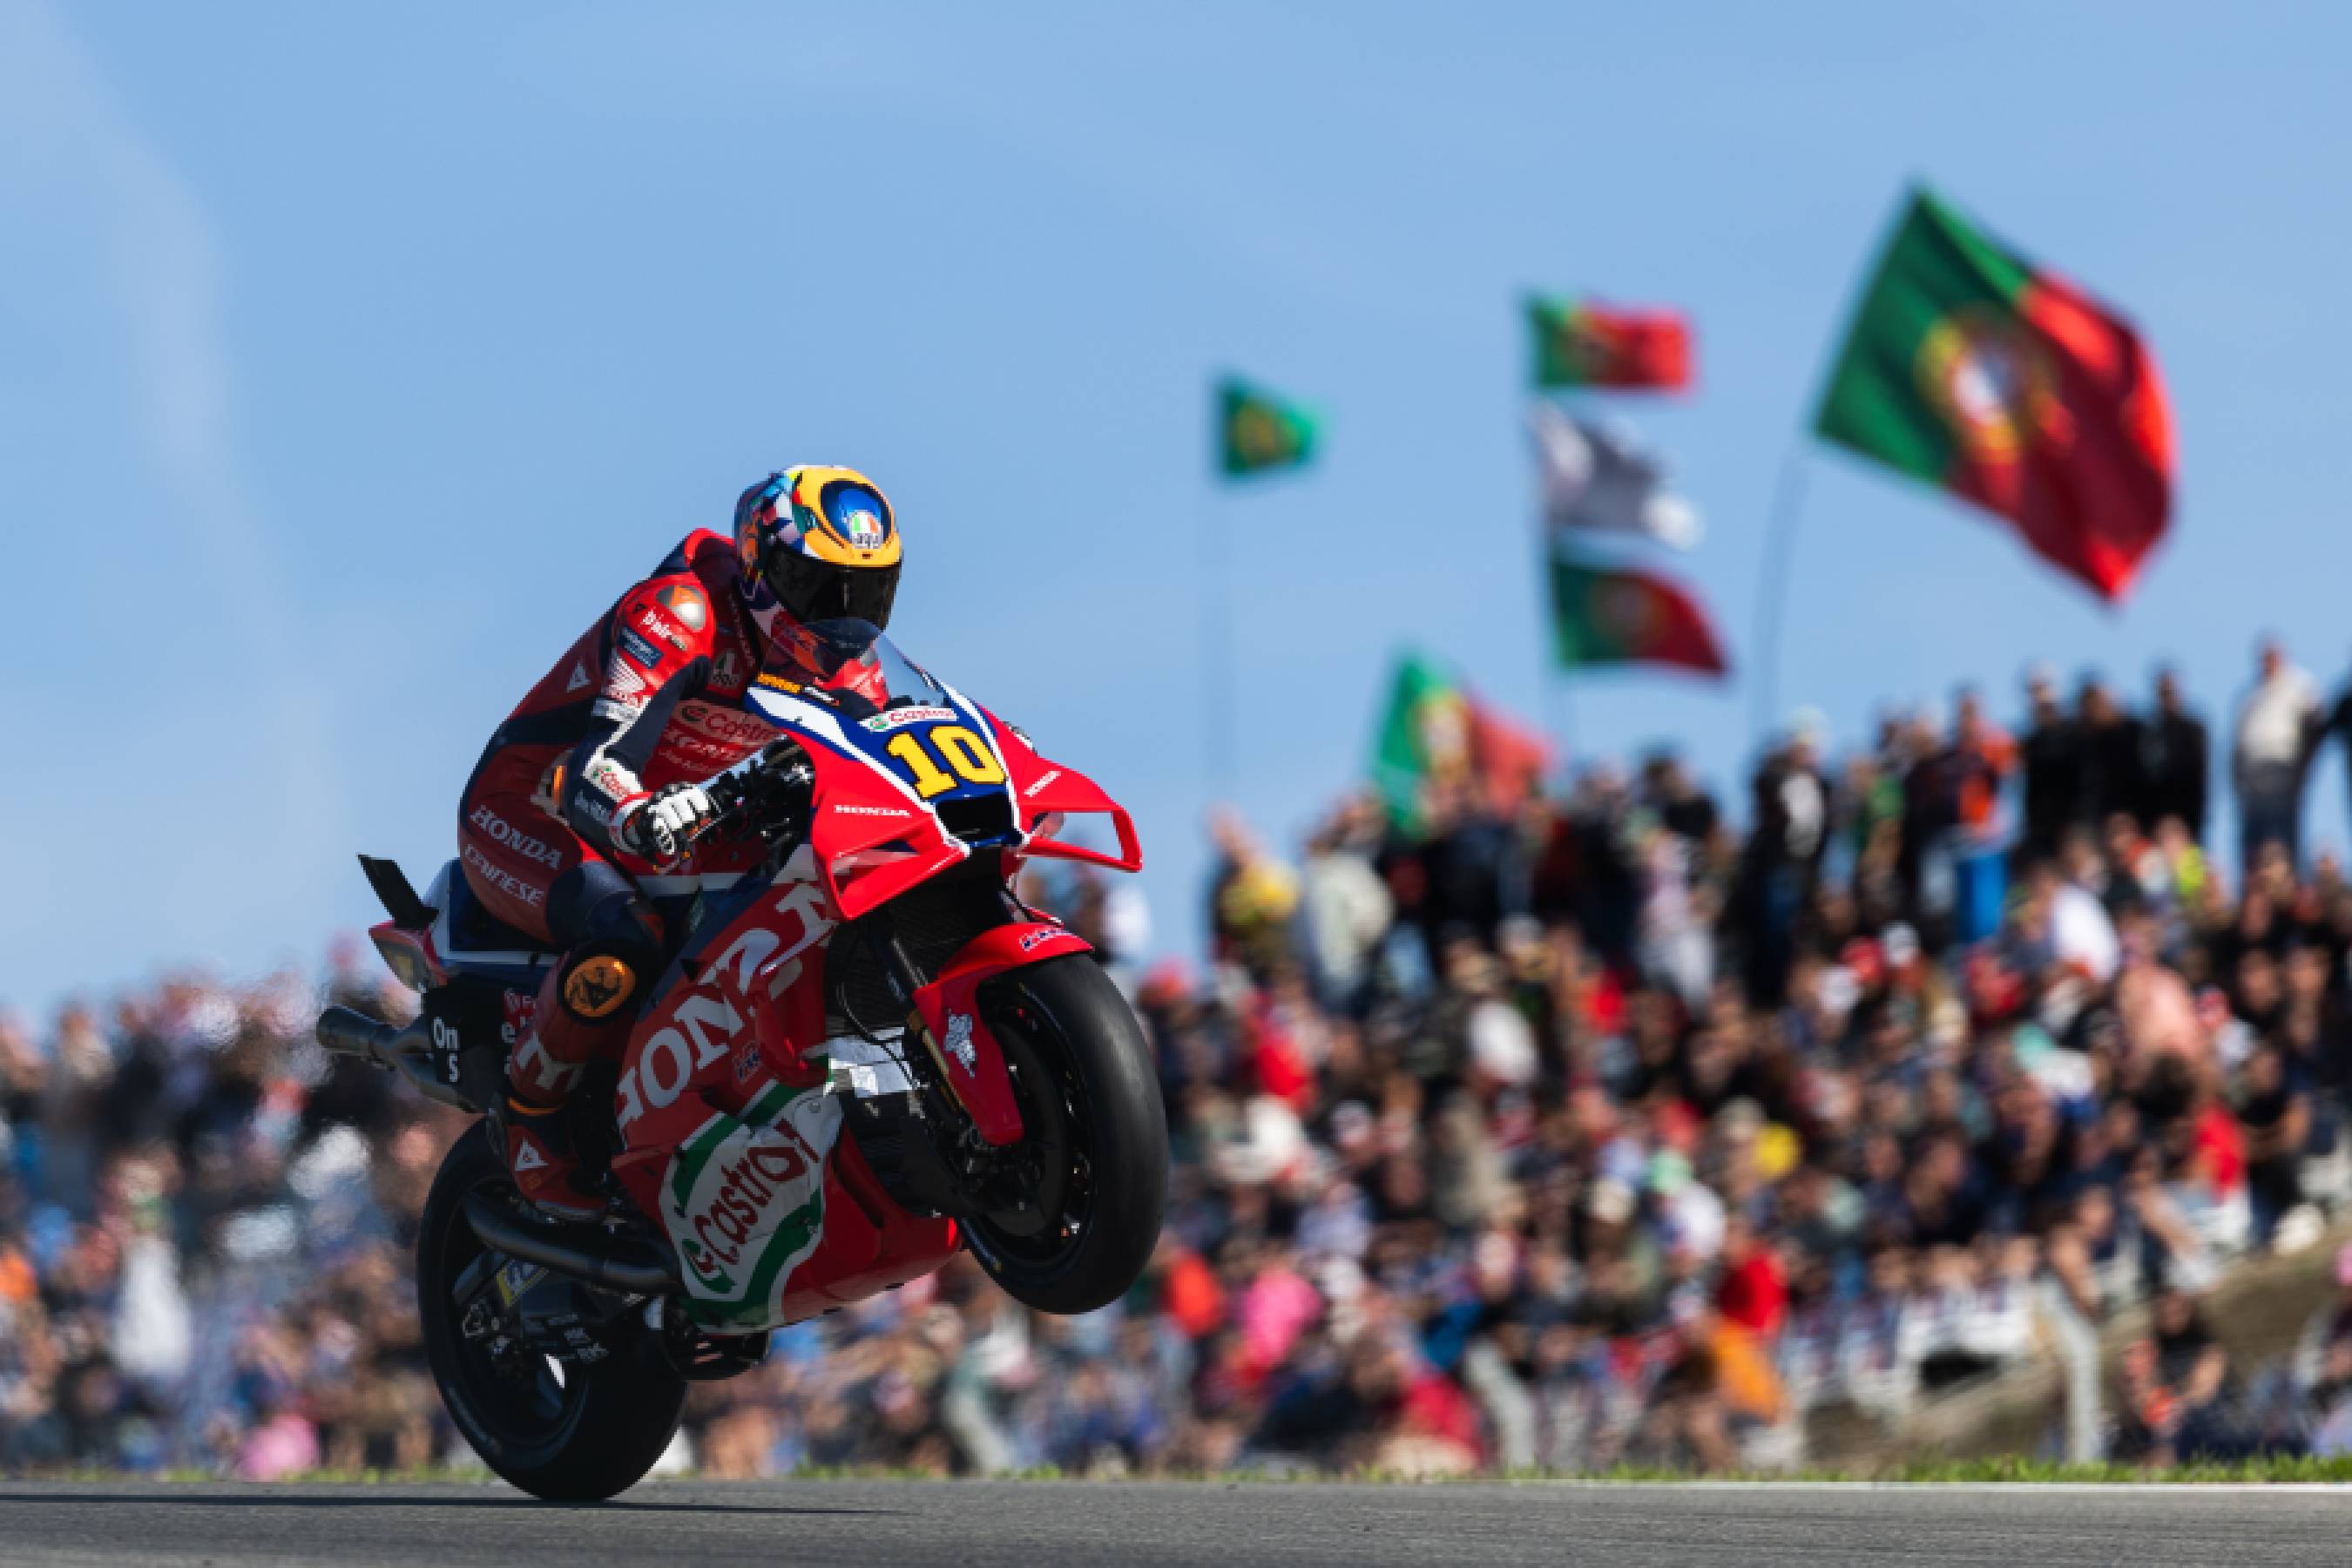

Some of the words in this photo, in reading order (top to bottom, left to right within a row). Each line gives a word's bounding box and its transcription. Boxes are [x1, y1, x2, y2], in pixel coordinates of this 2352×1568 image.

[884, 726, 1007, 800] 10
[469, 803, 564, 871] HONDA
[833, 803, 912, 818] HONDA
[693, 1118, 820, 1265] Castrol
